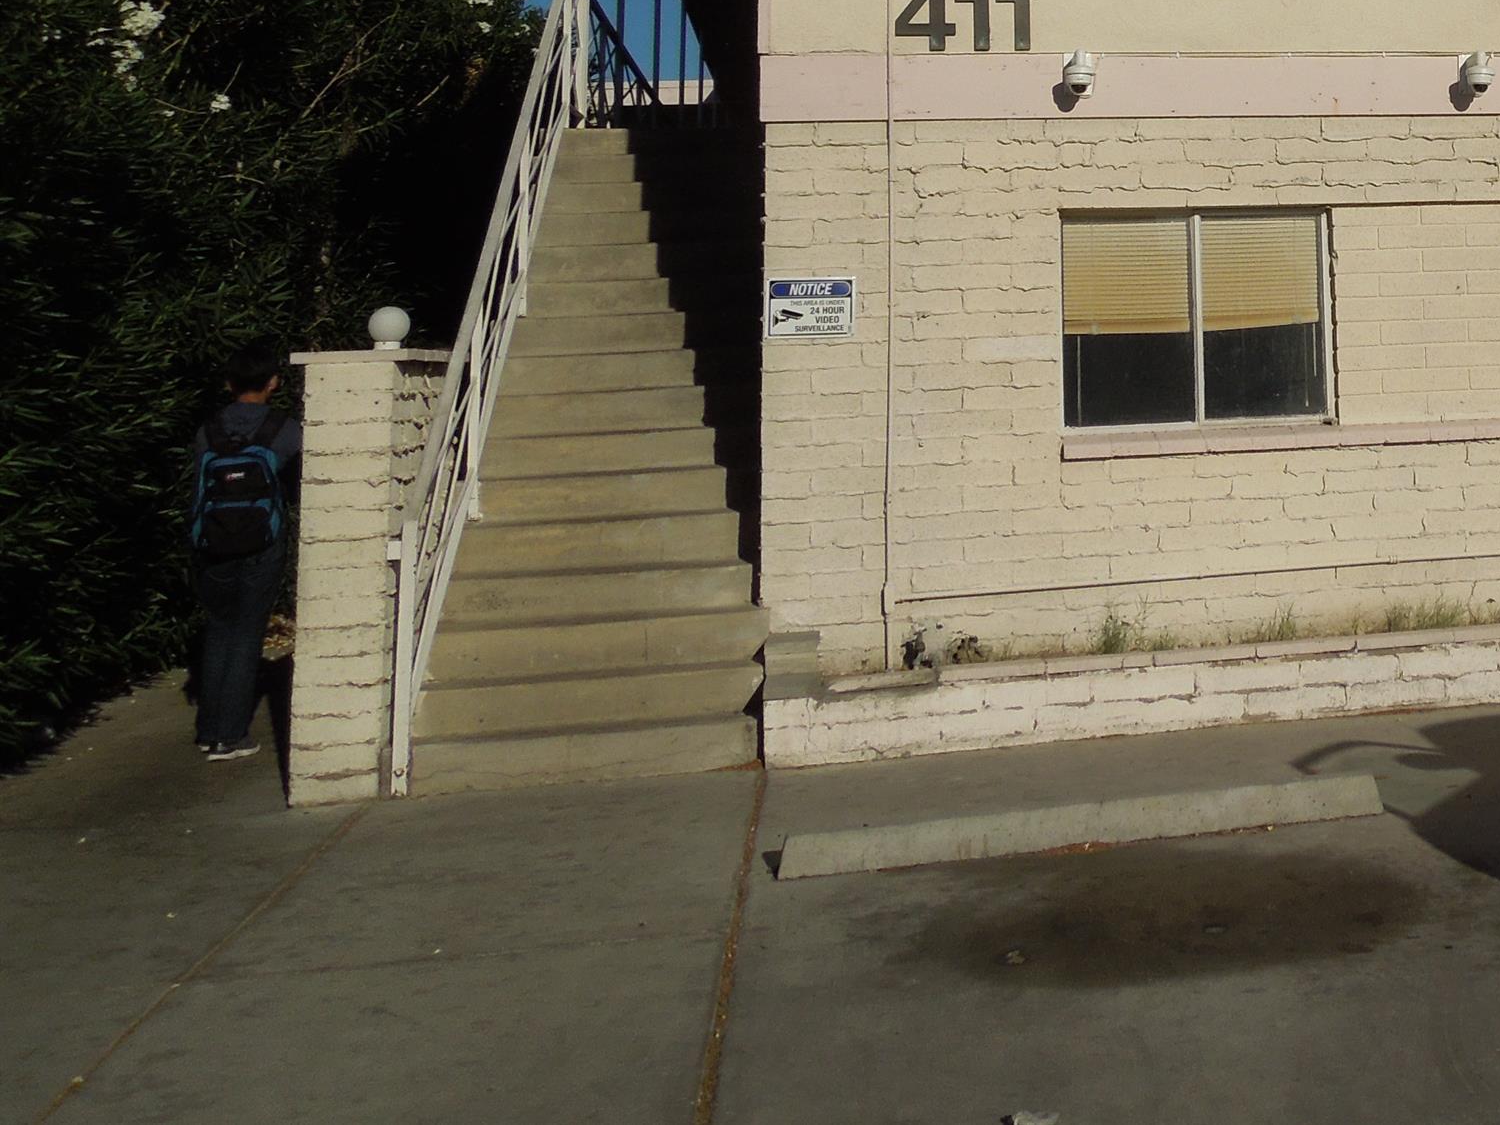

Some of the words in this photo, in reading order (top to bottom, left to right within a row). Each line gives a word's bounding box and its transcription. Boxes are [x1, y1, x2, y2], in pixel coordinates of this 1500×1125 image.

[789, 283, 833, 296] NOTICE
[810, 307, 820, 315] 24
[822, 306, 845, 314] HOUR
[815, 315, 840, 324] VIDEO
